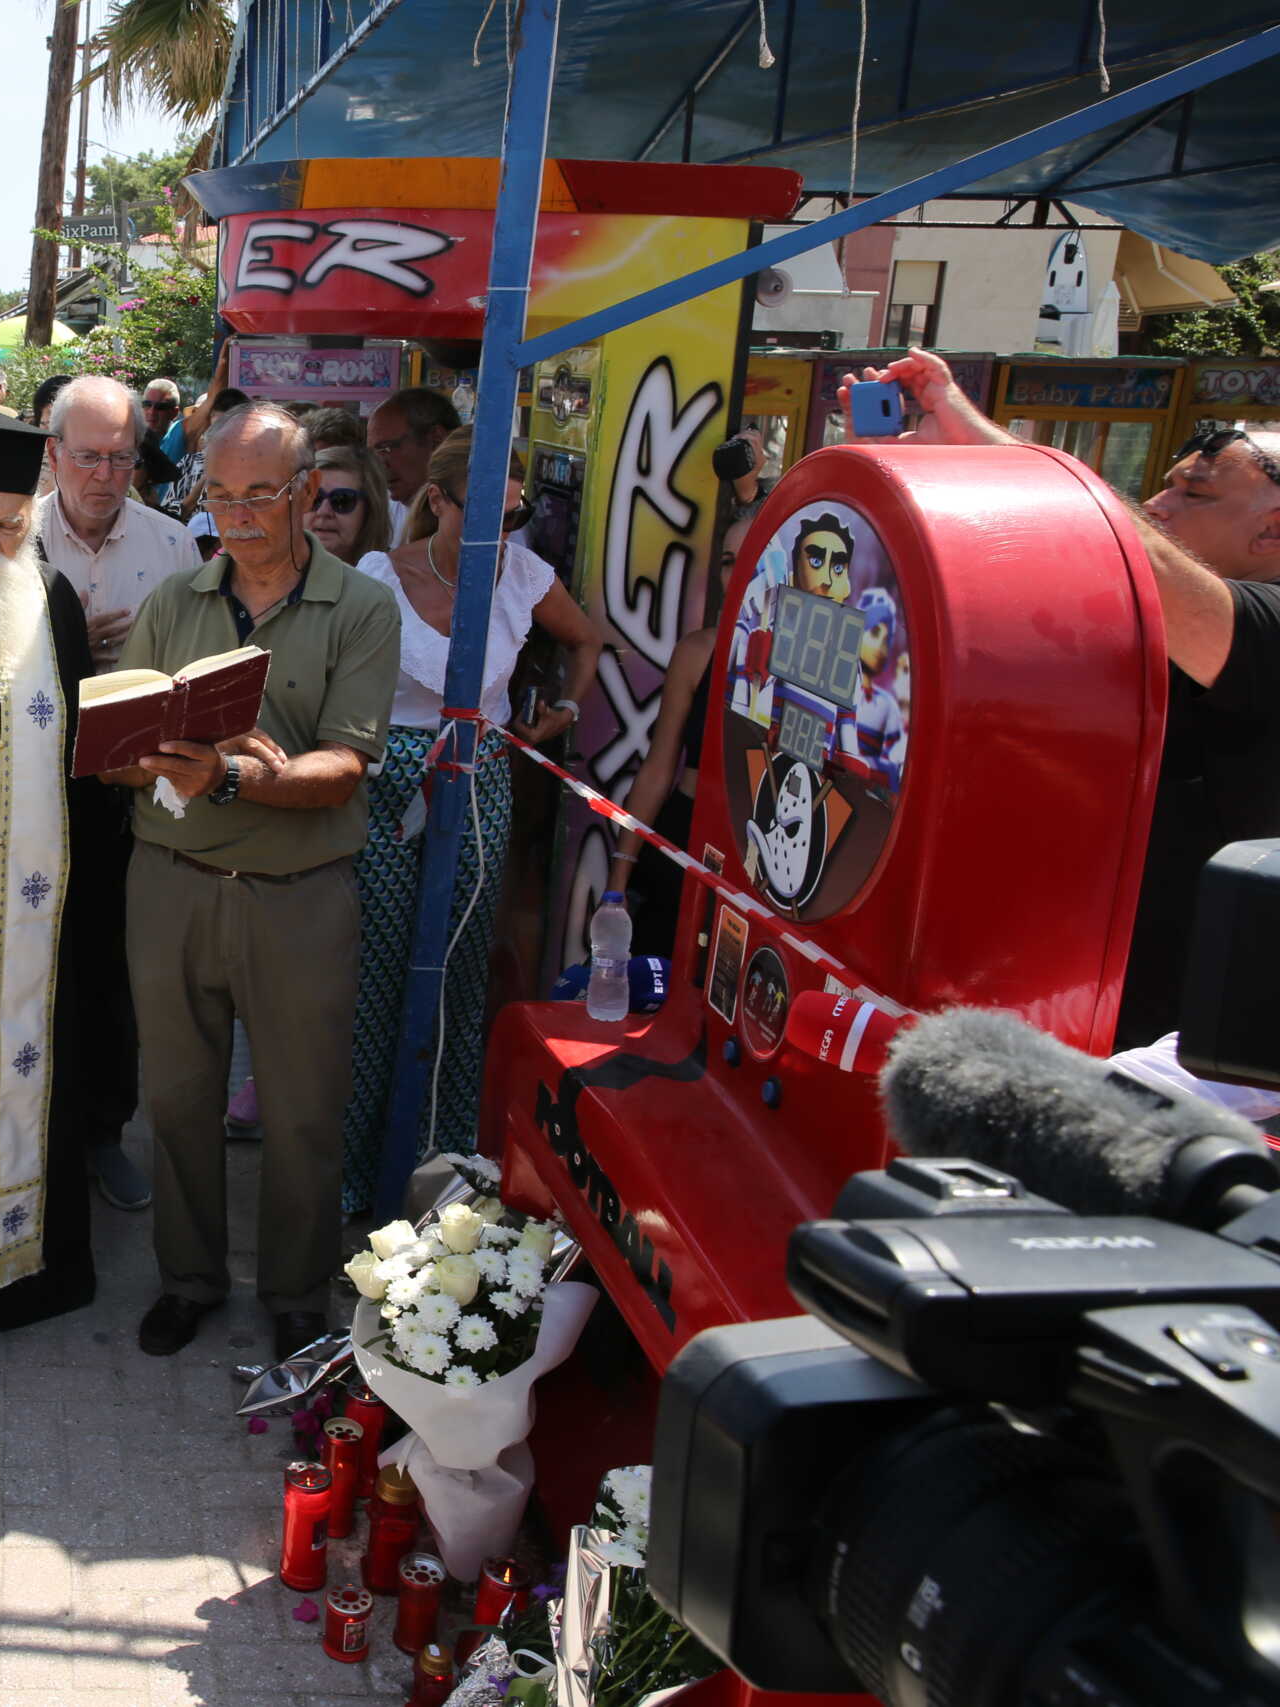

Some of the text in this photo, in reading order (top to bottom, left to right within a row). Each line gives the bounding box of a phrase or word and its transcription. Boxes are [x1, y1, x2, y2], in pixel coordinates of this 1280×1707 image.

[220, 218, 456, 299] ER
[1202, 370, 1265, 393] TOY
[1012, 383, 1168, 408] Baby Party
